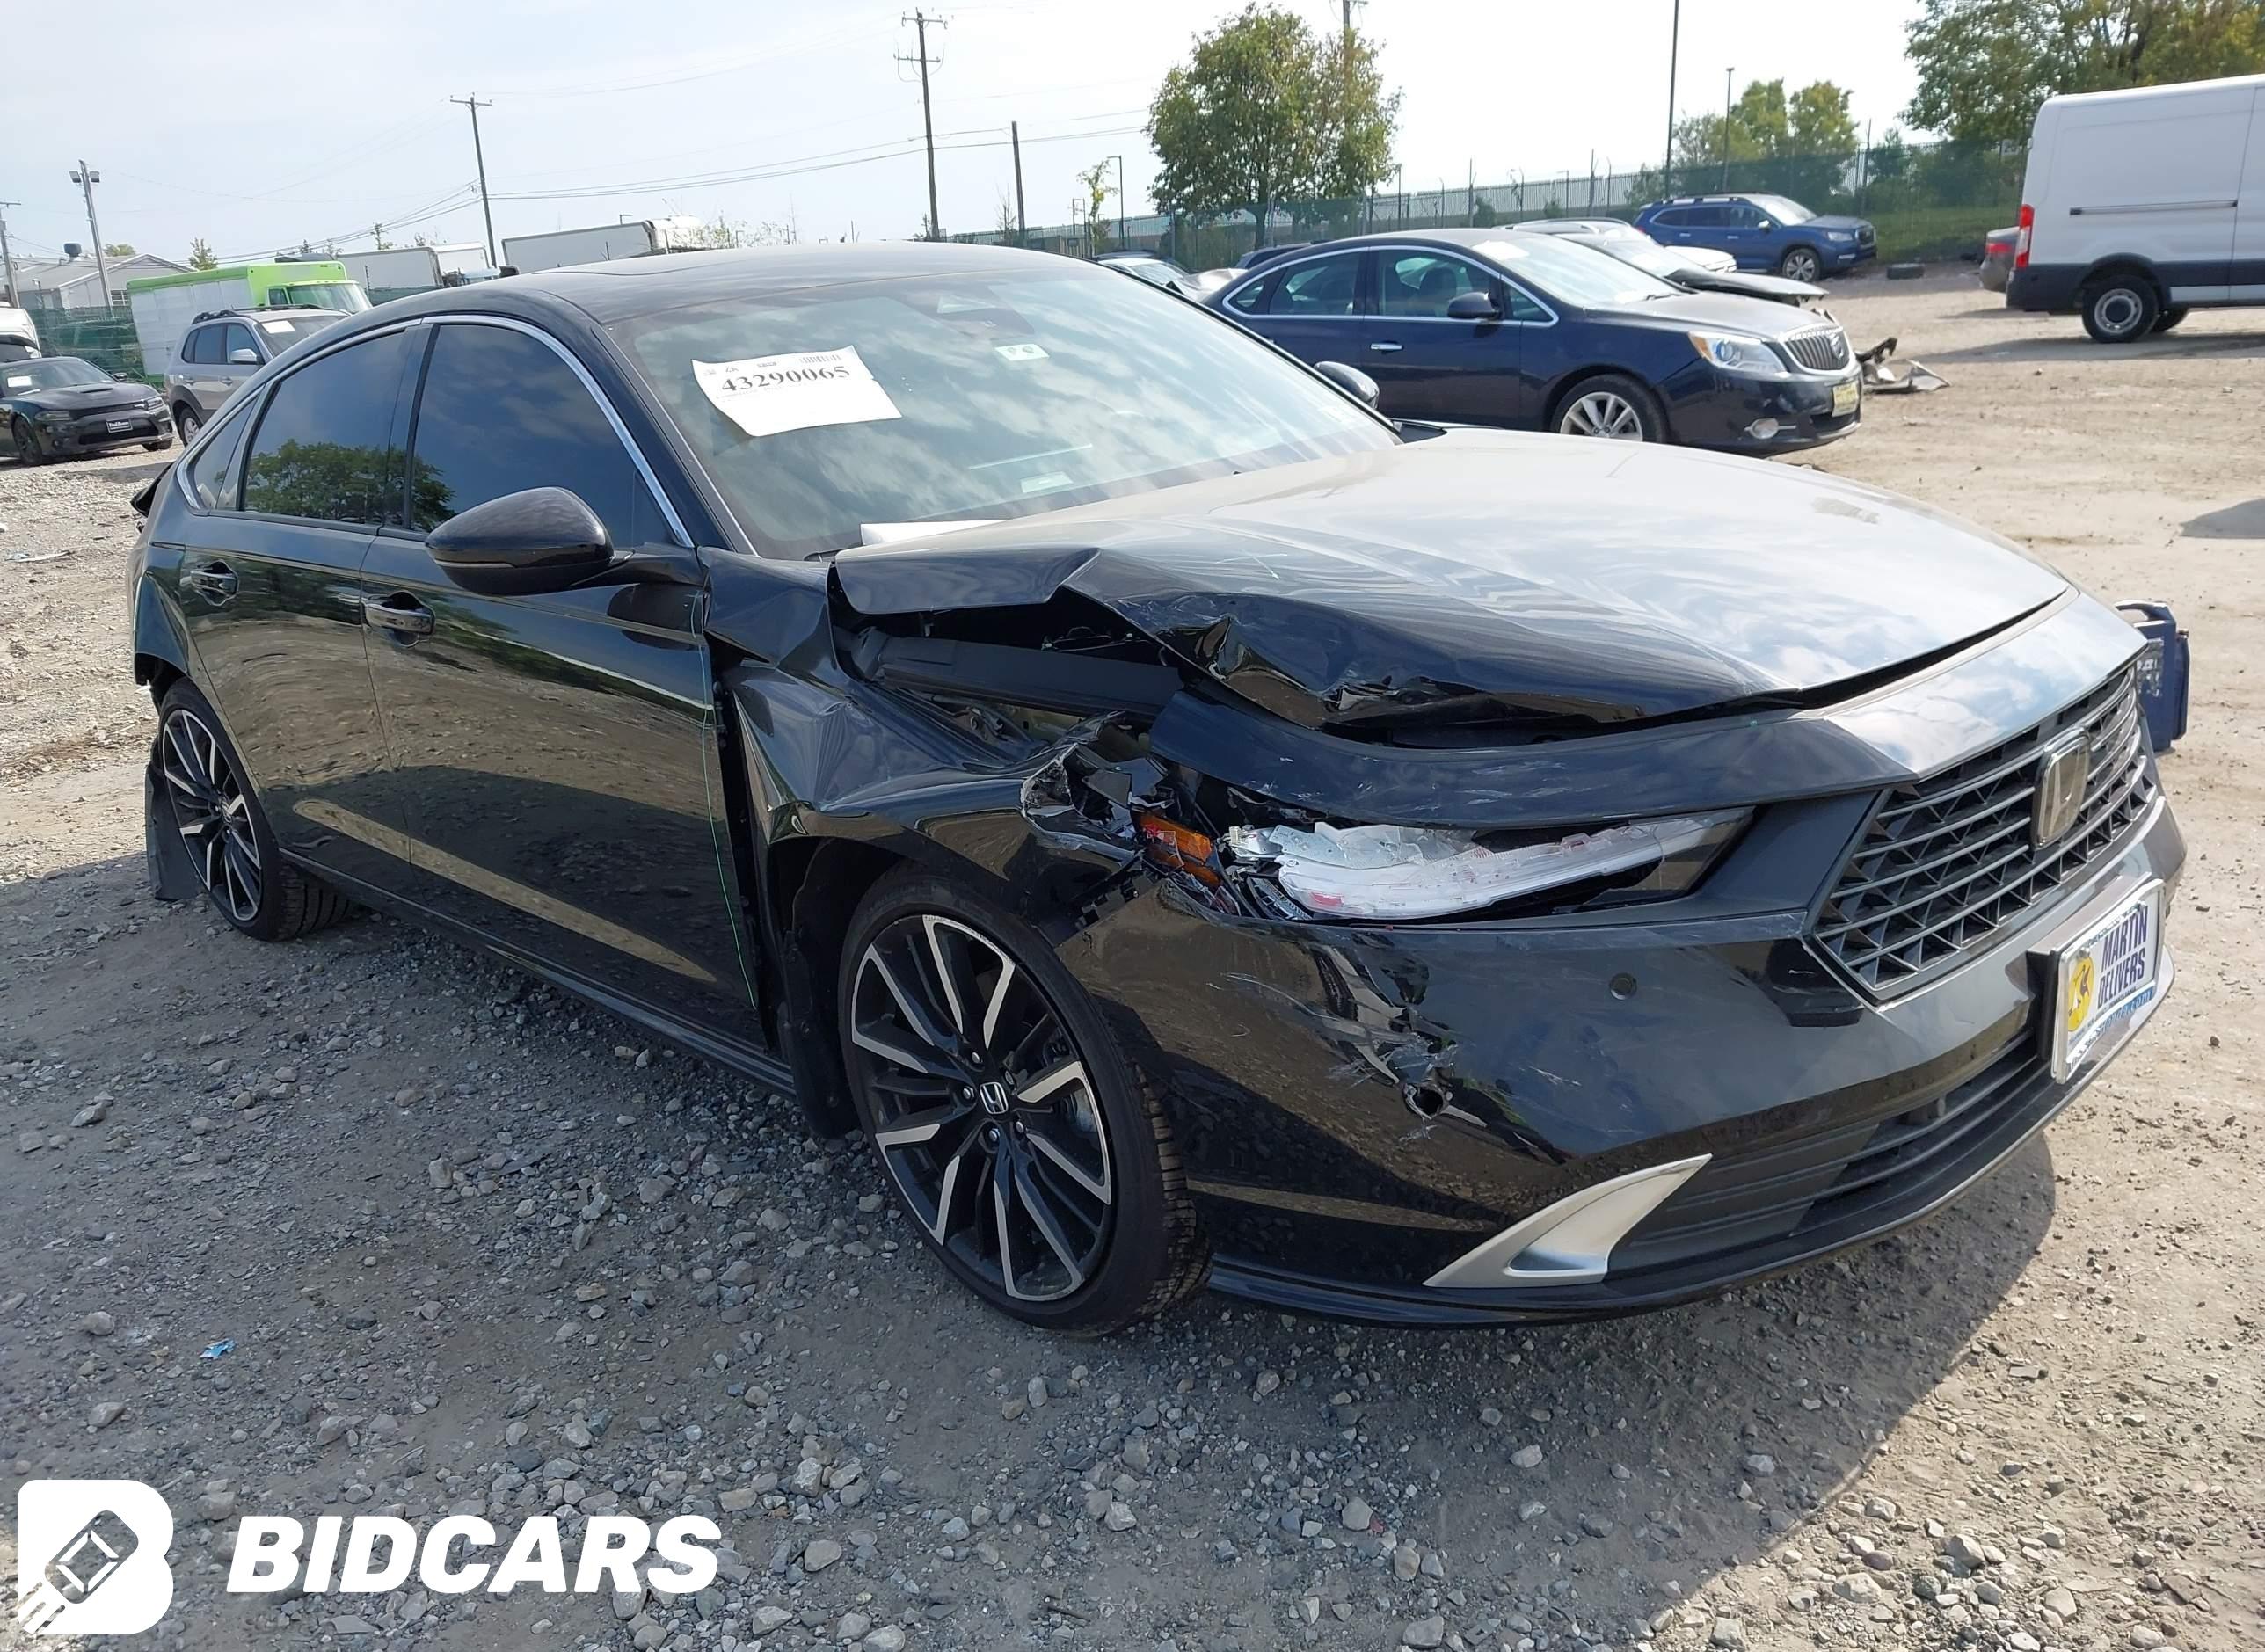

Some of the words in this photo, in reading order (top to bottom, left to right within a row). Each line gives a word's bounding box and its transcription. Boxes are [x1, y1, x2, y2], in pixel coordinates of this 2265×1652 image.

[721, 365, 851, 392] 43290065
[2101, 905, 2148, 973] MARTIN
[2097, 947, 2146, 1010] DELIVERS
